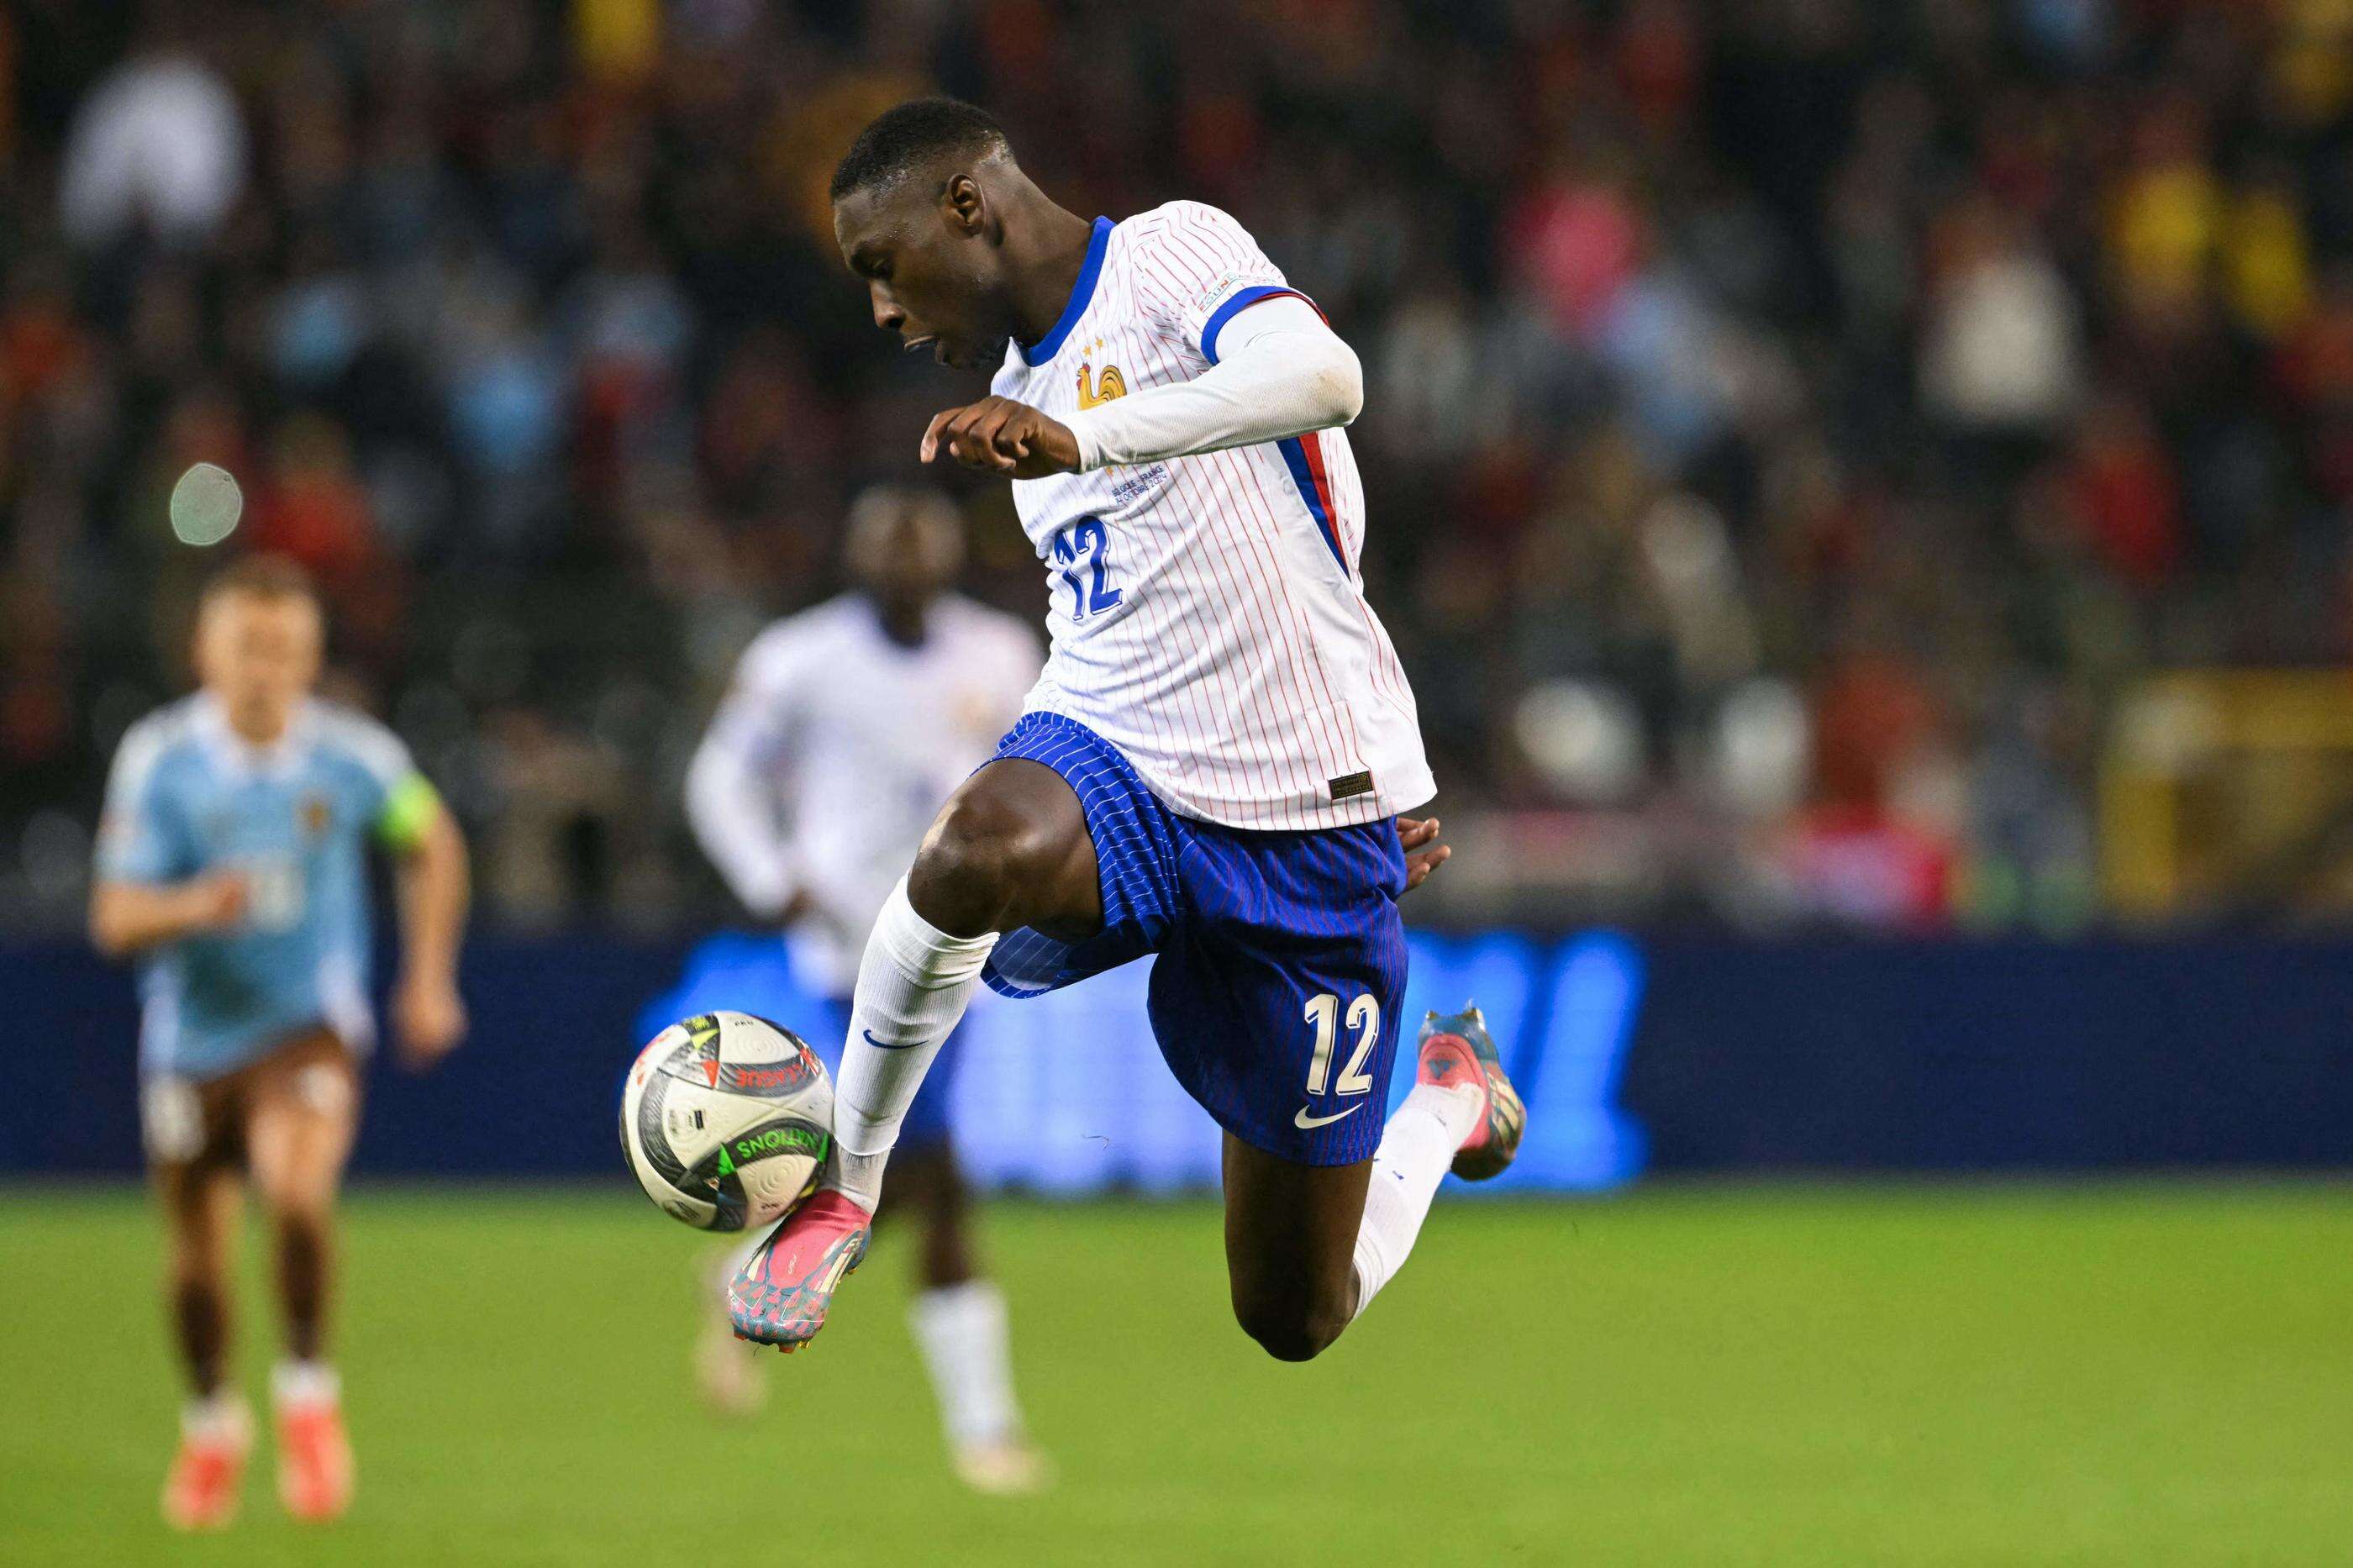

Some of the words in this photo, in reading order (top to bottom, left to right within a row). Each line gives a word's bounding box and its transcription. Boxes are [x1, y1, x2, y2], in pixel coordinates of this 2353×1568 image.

[1148, 472, 1168, 488] 2024
[1054, 515, 1123, 621] 12
[1304, 992, 1380, 1097] 12
